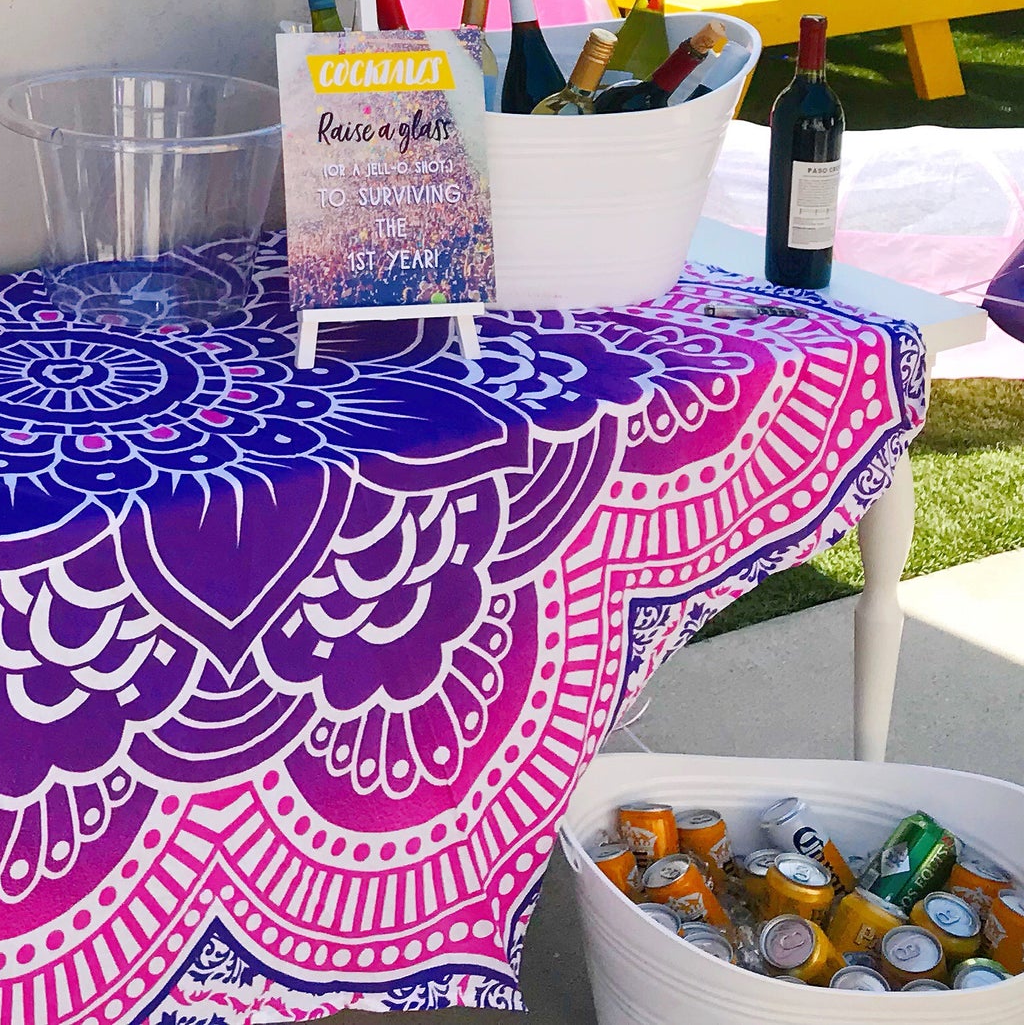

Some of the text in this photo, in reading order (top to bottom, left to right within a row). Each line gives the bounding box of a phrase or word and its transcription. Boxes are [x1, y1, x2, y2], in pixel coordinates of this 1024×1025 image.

[319, 56, 442, 87] COCKTAILS
[317, 109, 451, 154] Raise a glass
[352, 163, 361, 176] A
[366, 162, 409, 177] JELL-O
[317, 183, 462, 208] TO SURVIVING
[375, 217, 407, 238] THE
[347, 248, 440, 272] 1ST YEAR!
